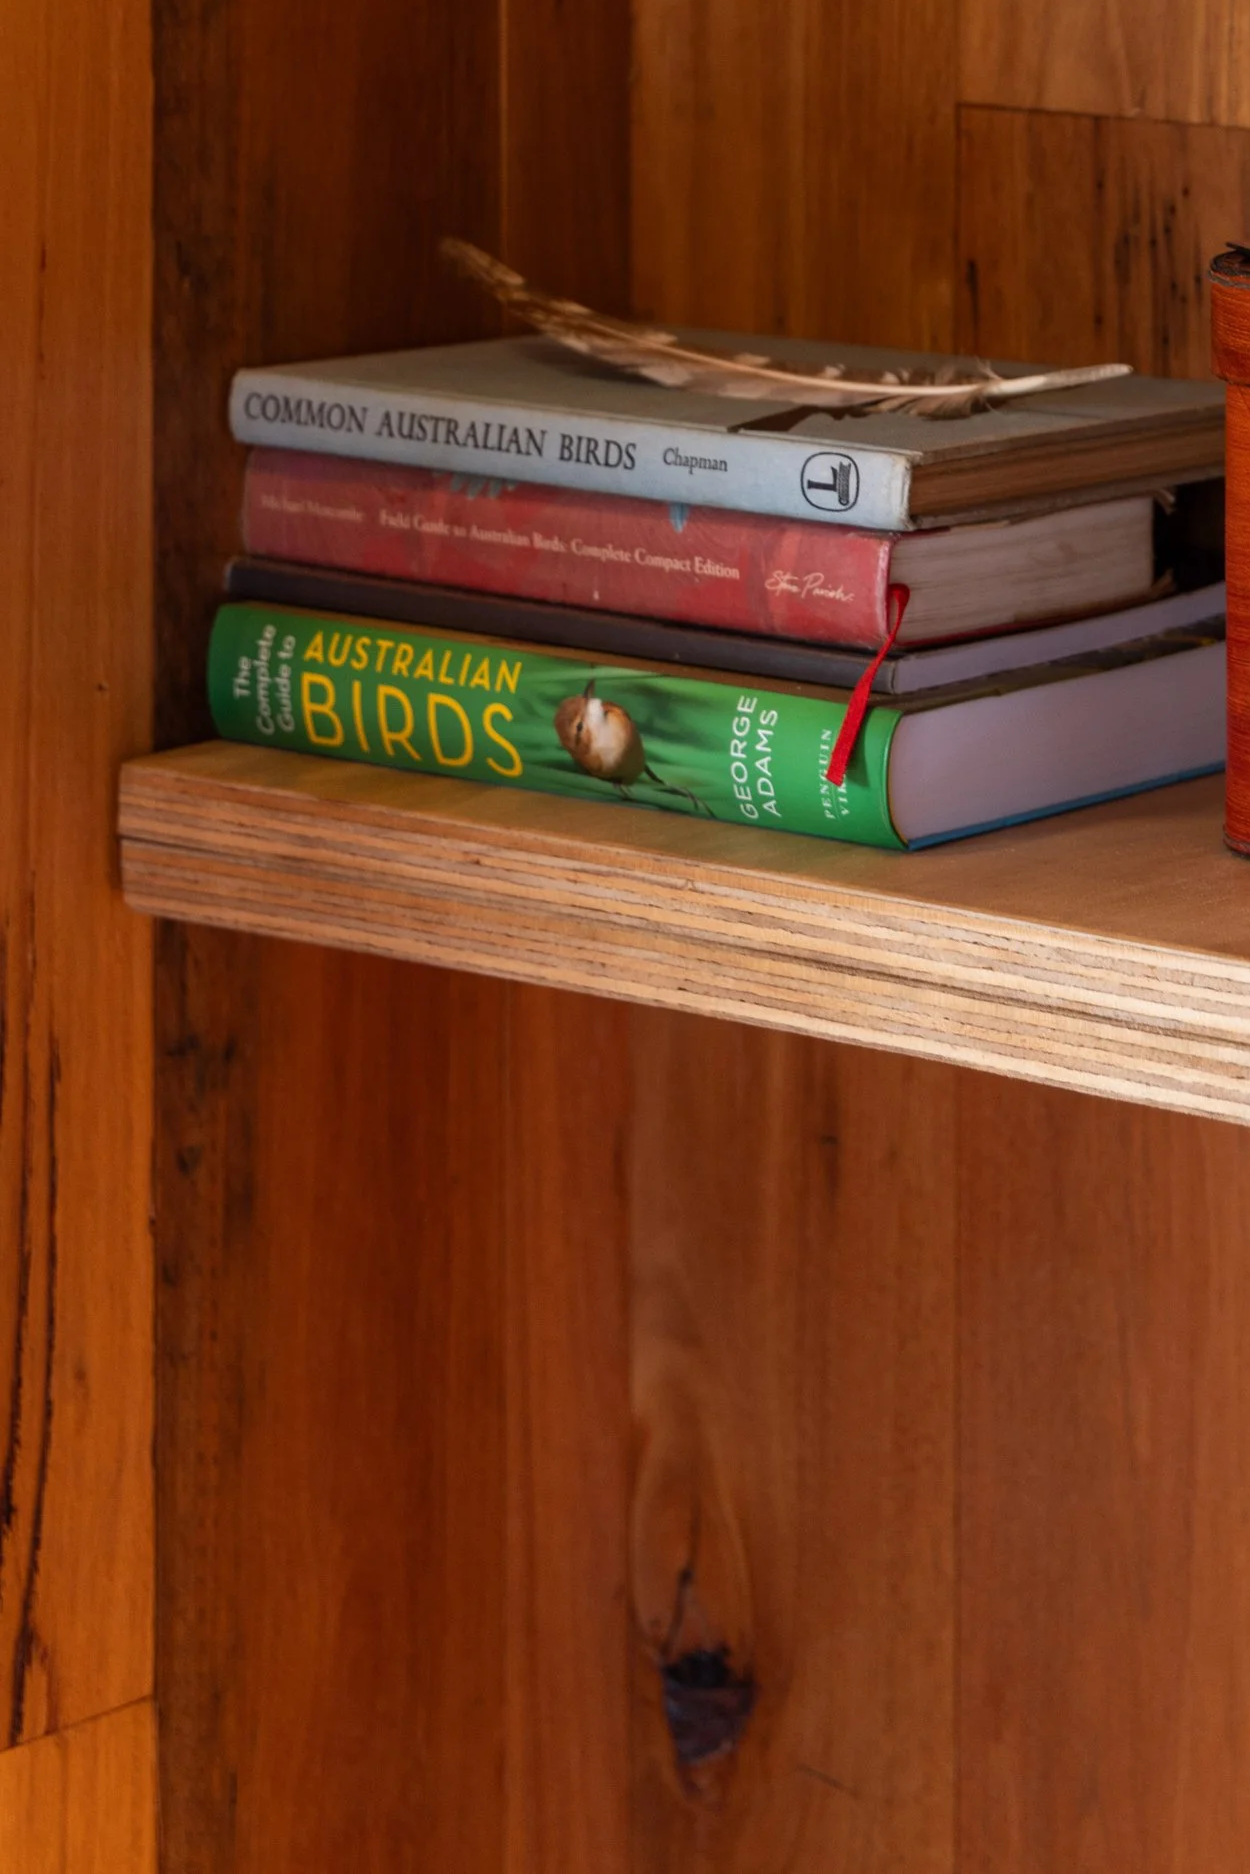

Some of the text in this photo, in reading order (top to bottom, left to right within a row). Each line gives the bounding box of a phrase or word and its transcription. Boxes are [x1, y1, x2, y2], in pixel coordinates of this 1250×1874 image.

[243, 392, 637, 471] COMMON AUSTRALIAN BIRDS
[662, 447, 728, 475] Chapman
[379, 509, 410, 530] Field
[413, 514, 450, 535] Guide
[452, 524, 467, 537] to
[469, 524, 531, 548] Australian
[570, 538, 631, 563] Complete
[634, 547, 692, 573] Compact
[694, 556, 741, 579] Edition
[232, 655, 252, 700] The
[253, 624, 277, 736] Complete
[274, 634, 296, 733] Guide to
[303, 630, 523, 694] AUSTRALIAN
[301, 671, 524, 777] BIRDS
[730, 694, 758, 820] GEORGE
[755, 709, 783, 818] ADAMS
